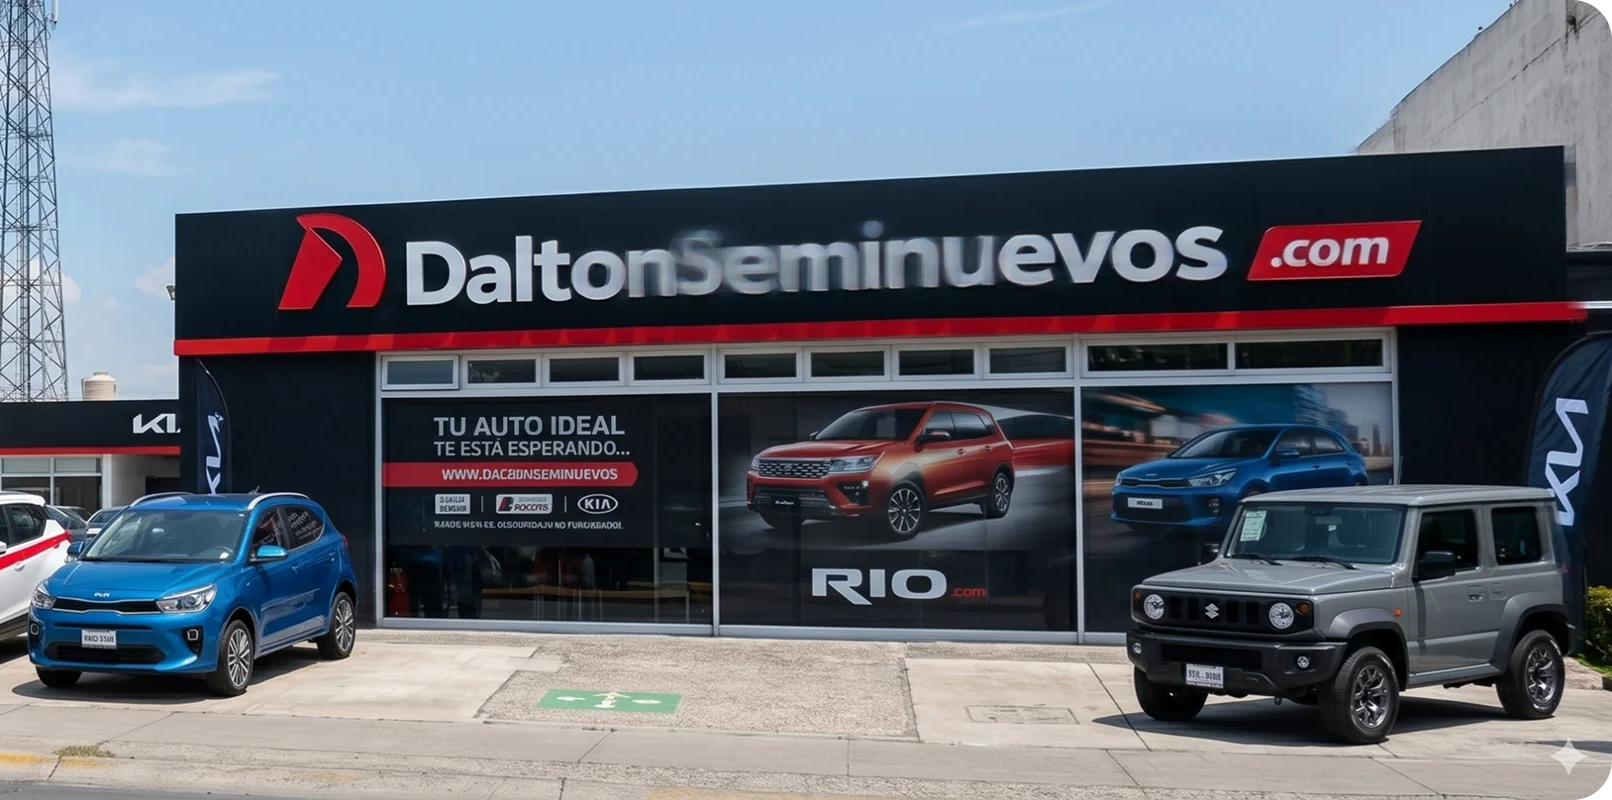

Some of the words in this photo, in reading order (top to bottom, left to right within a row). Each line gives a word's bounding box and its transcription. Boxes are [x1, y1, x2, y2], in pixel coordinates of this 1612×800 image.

[406, 221, 1228, 306] DaltonSeminuevos
[1271, 235, 1389, 268] .com
[133, 413, 181, 434] KI
[433, 417, 466, 436] TU
[473, 416, 543, 437] AUTO
[550, 415, 625, 436] IDEAL
[433, 441, 456, 456] TE
[460, 437, 504, 456] ESTÁ
[508, 440, 630, 456] ESPERANDO...
[584, 498, 611, 510] KIA
[812, 568, 947, 605] RIO
[951, 587, 986, 597] .com
